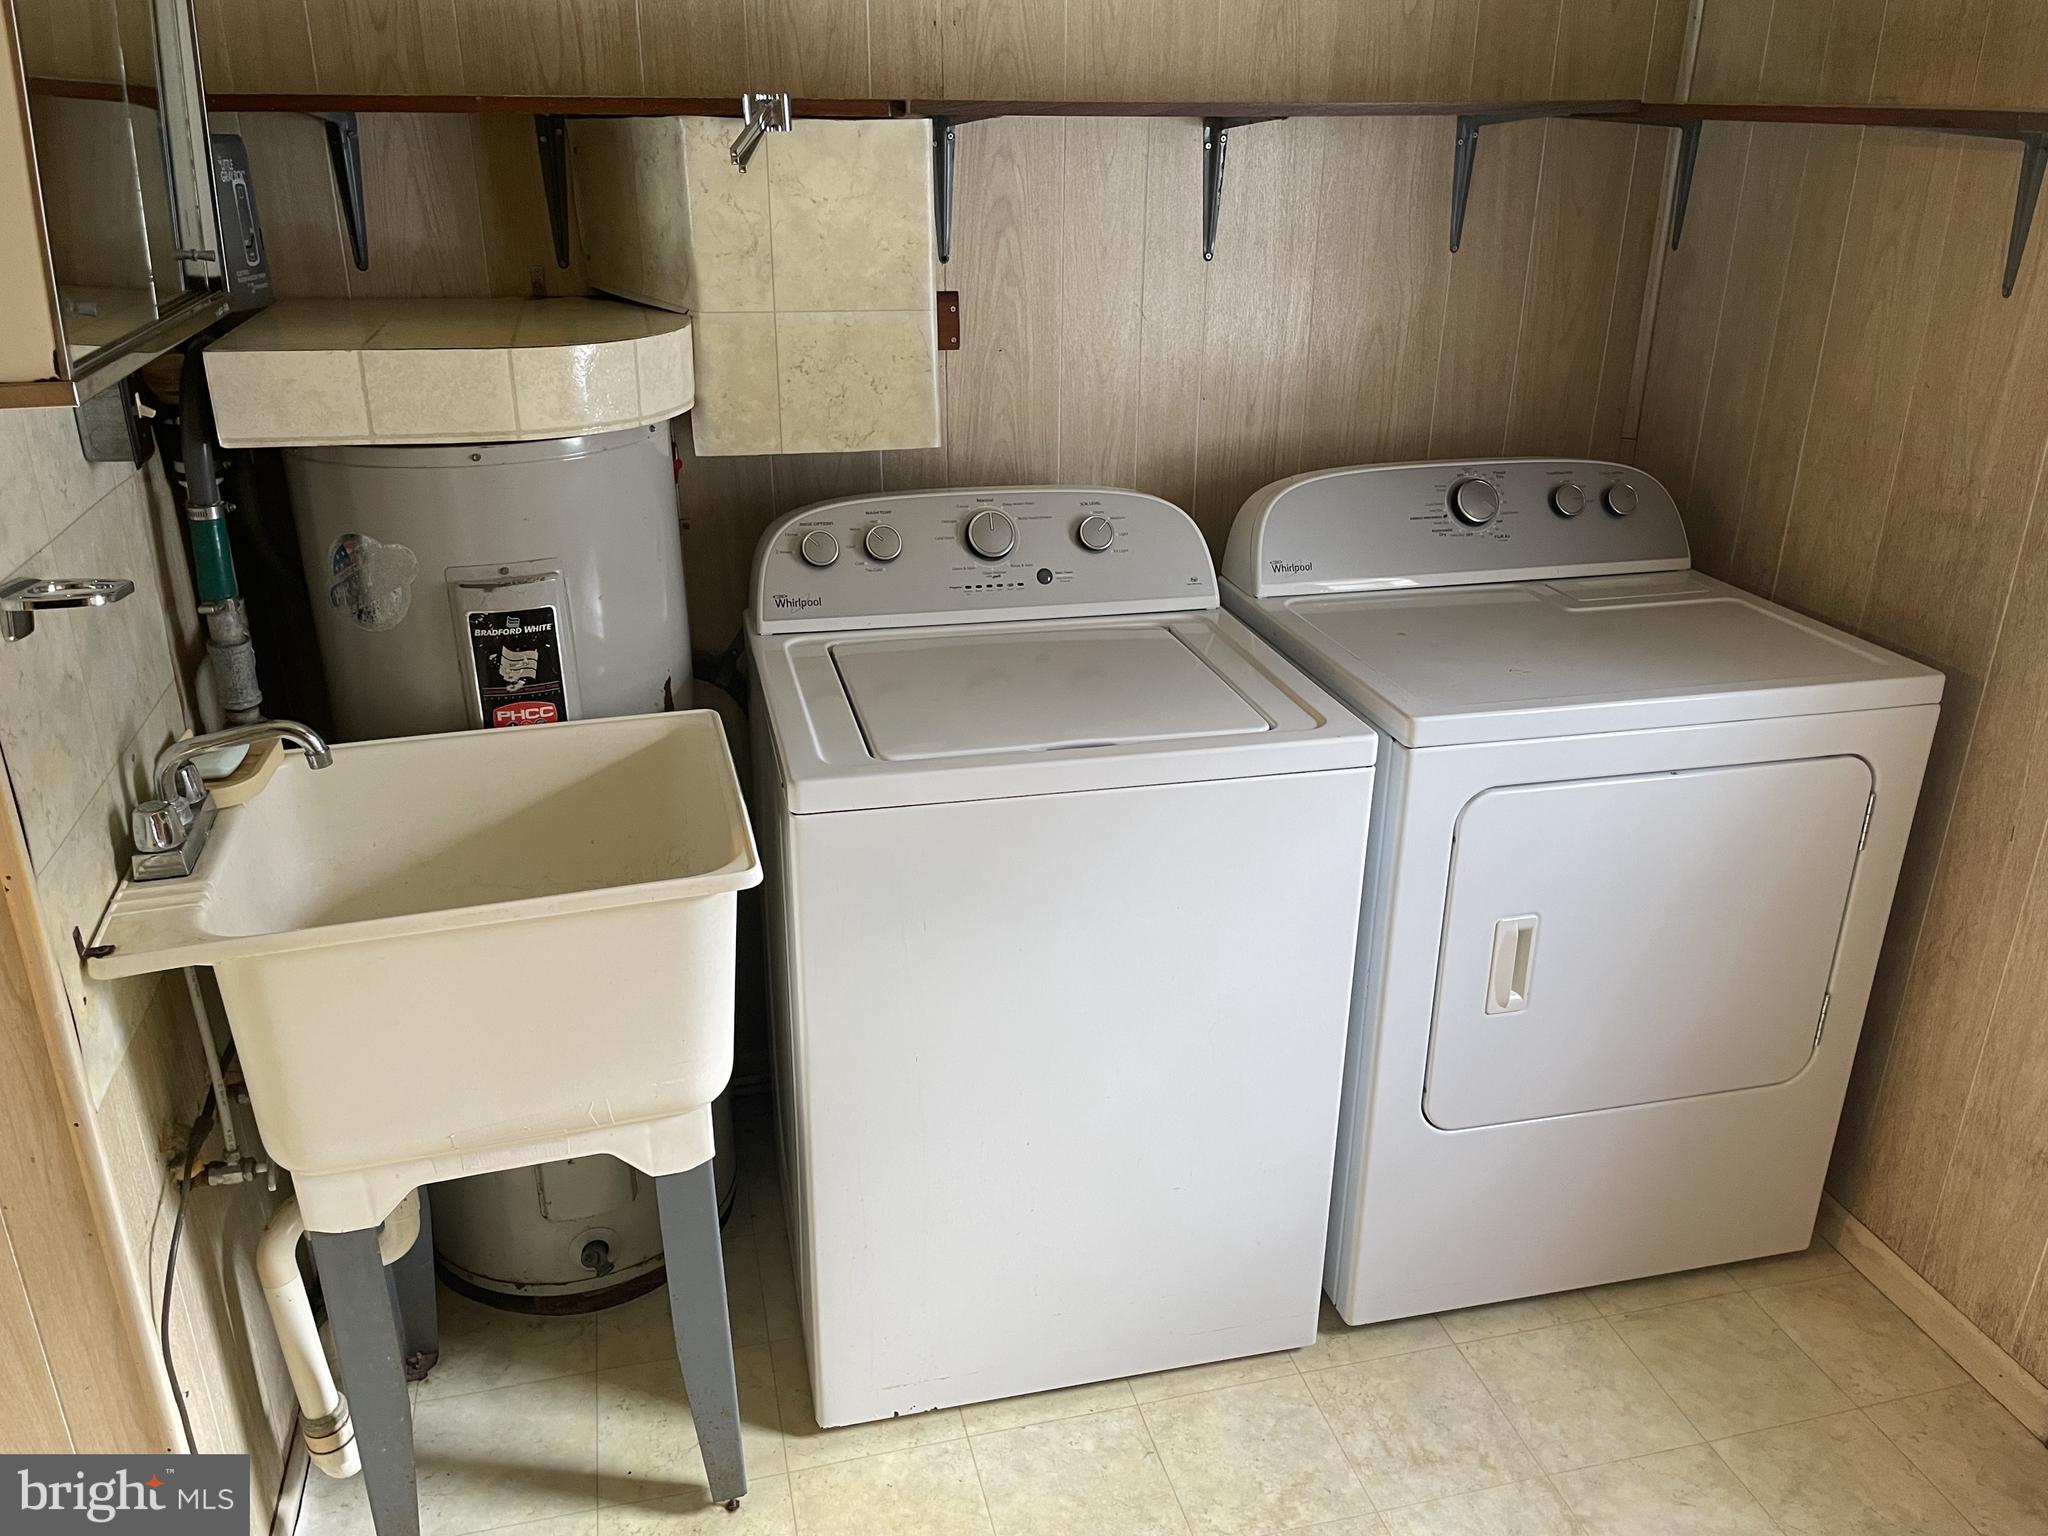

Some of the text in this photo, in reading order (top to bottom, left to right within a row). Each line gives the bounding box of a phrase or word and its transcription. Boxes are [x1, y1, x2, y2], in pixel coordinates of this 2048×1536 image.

[1271, 562, 1313, 574] Whirlpool
[774, 597, 822, 610] Whirlpool
[474, 623, 552, 637] BRADFORD WHITE
[496, 706, 555, 721] PHCC
